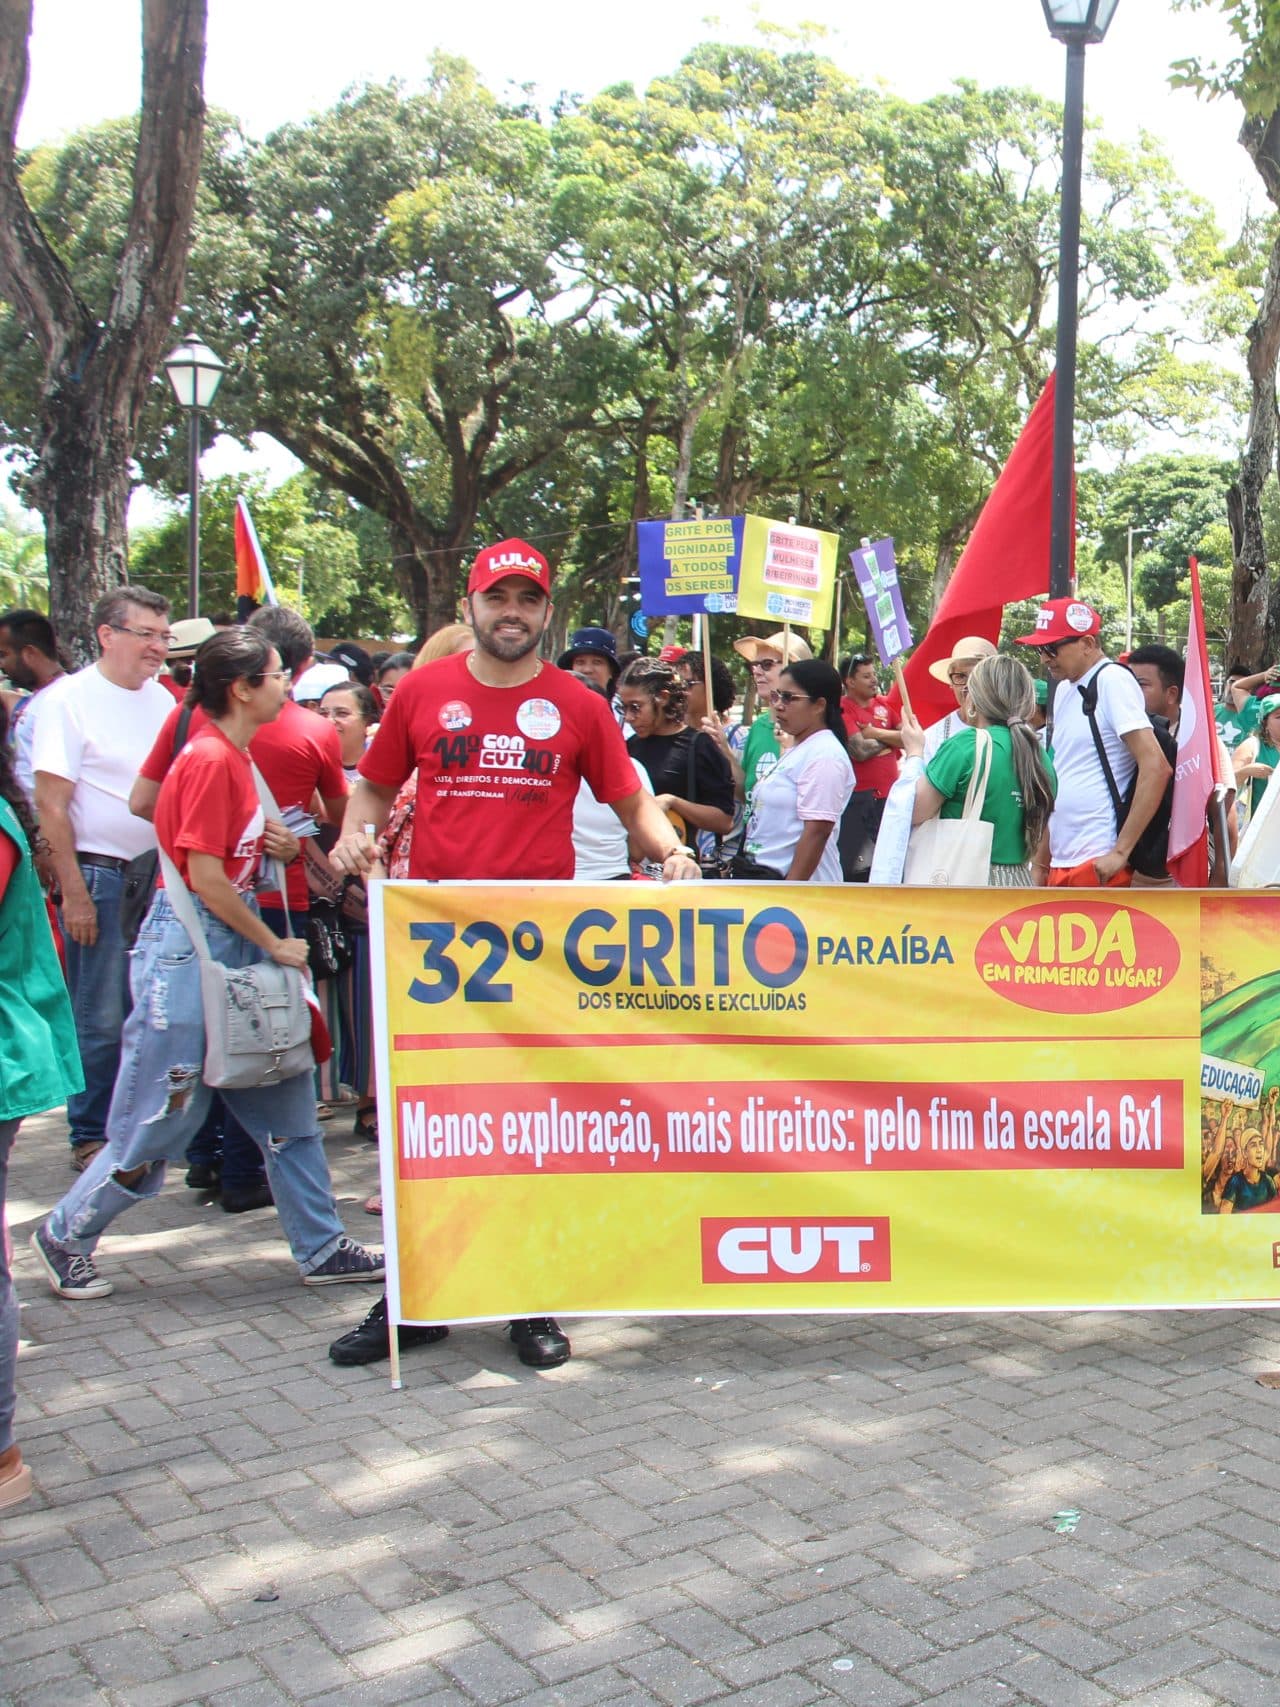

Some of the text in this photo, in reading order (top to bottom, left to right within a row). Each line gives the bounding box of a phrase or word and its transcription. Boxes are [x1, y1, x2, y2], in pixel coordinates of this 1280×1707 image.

[665, 524, 732, 537] GRITE POR
[489, 552, 538, 570] LULA
[665, 542, 735, 556] DIGNIDADE
[672, 561, 727, 573] A TODOS
[667, 582, 686, 592] OS
[482, 749, 553, 775] CUT 40
[456, 775, 492, 784] DIREITOS
[494, 776, 500, 784] E
[502, 776, 552, 787] DEMOCRACIA
[450, 790, 505, 798] TRANSFORMAM
[1000, 908, 1137, 968] VIDA
[407, 906, 955, 1004] 32º GRITO PARAÍBA
[983, 962, 1163, 988] EM PRIMEIRO LUGAR!
[578, 988, 807, 1012] DOS EXCLUÍDOS E EXCLUÍDAS
[1200, 1064, 1261, 1100] EDUCAÇÃO
[402, 1094, 1163, 1168] Menos exploração, mais direitos: pelo fim da escala 6x1
[717, 1226, 874, 1275] CUT
